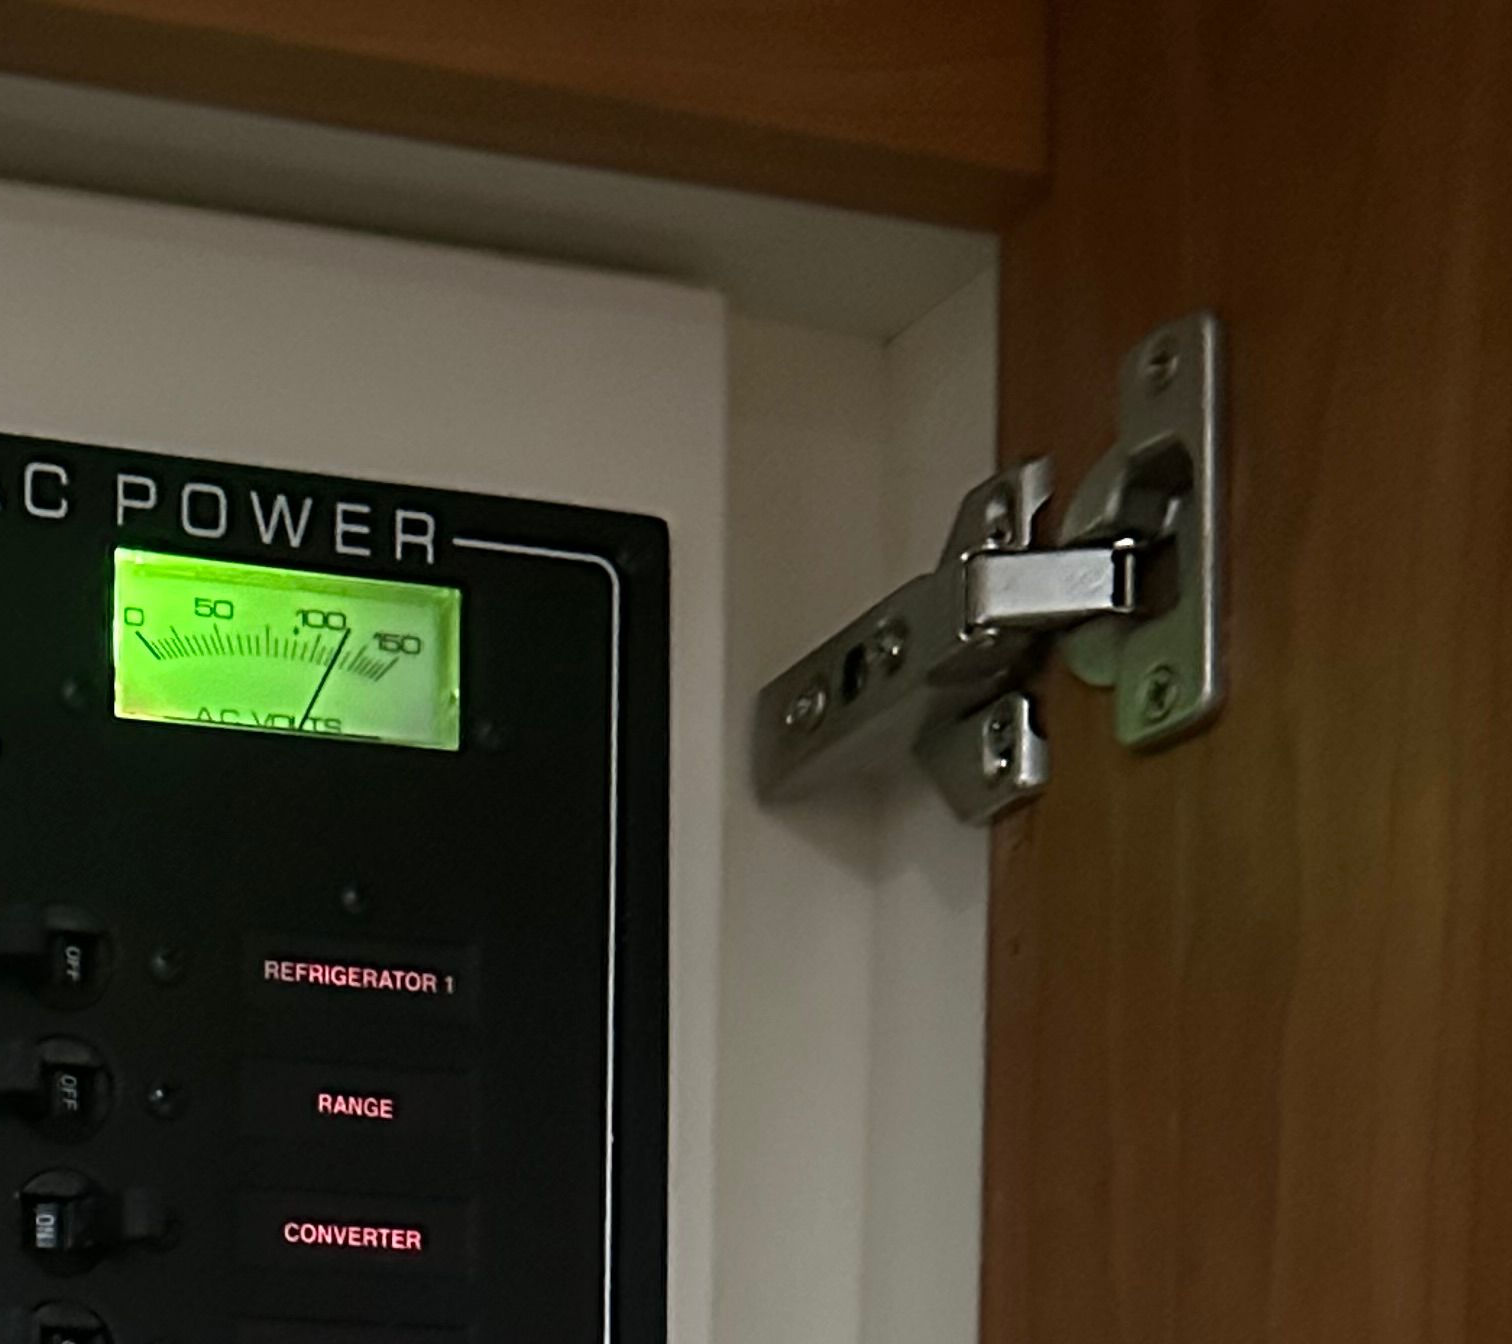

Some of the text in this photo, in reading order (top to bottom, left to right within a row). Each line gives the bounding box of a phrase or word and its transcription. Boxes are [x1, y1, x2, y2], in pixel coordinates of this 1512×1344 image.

[115, 471, 439, 565] POWER
[124, 597, 422, 656] 0 50 100 150
[264, 960, 453, 993] REFRIGERATOR 1
[317, 1093, 393, 1119] RANGE
[283, 1222, 422, 1250] CONVERTER
